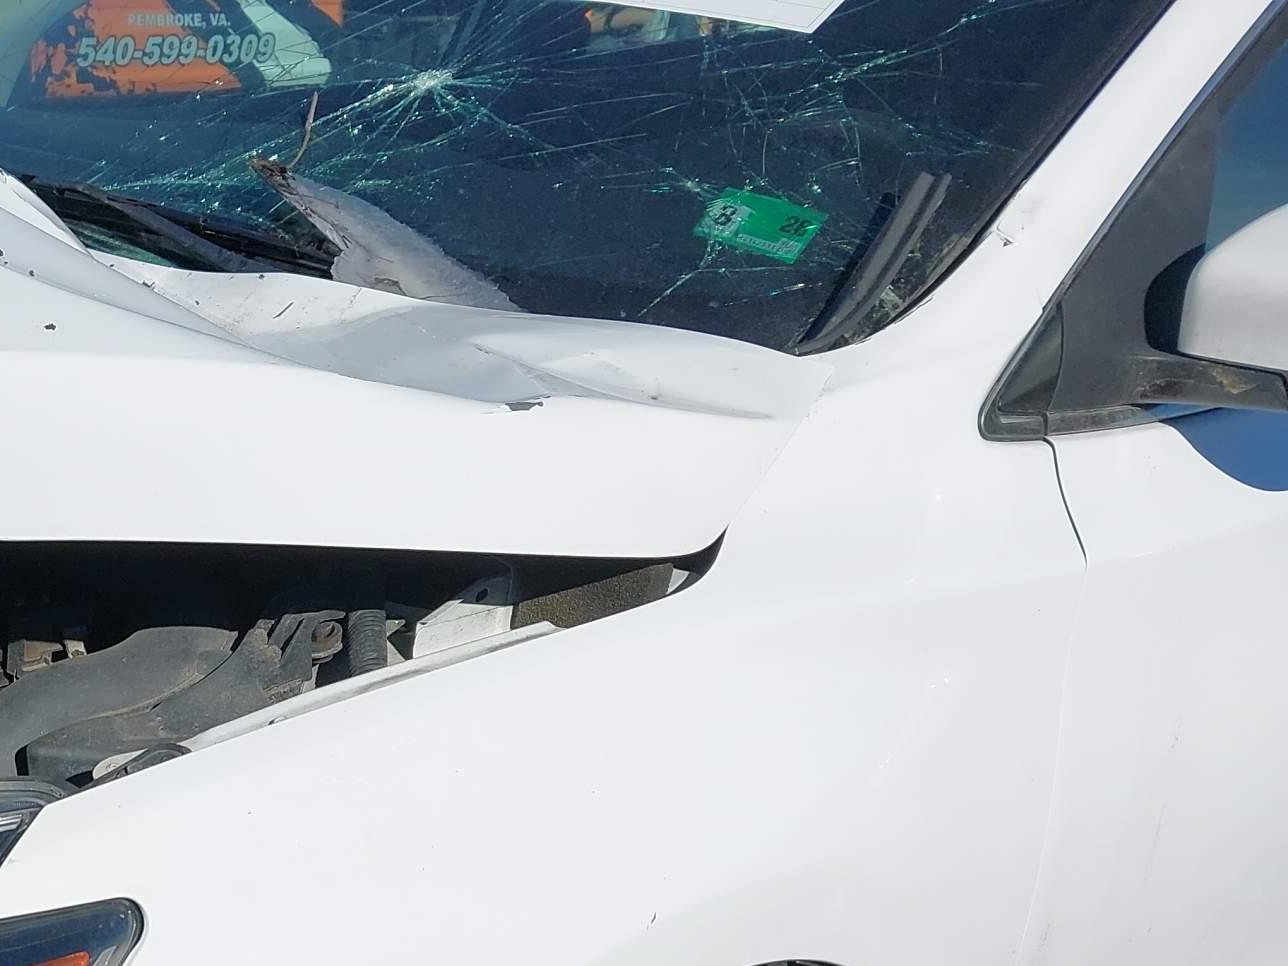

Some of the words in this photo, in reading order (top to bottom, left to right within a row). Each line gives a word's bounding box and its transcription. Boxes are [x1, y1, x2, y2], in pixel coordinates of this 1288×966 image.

[127, 13, 207, 28] PEMBROKE,
[210, 13, 231, 27] VA.
[77, 32, 277, 67] 540-599-0309
